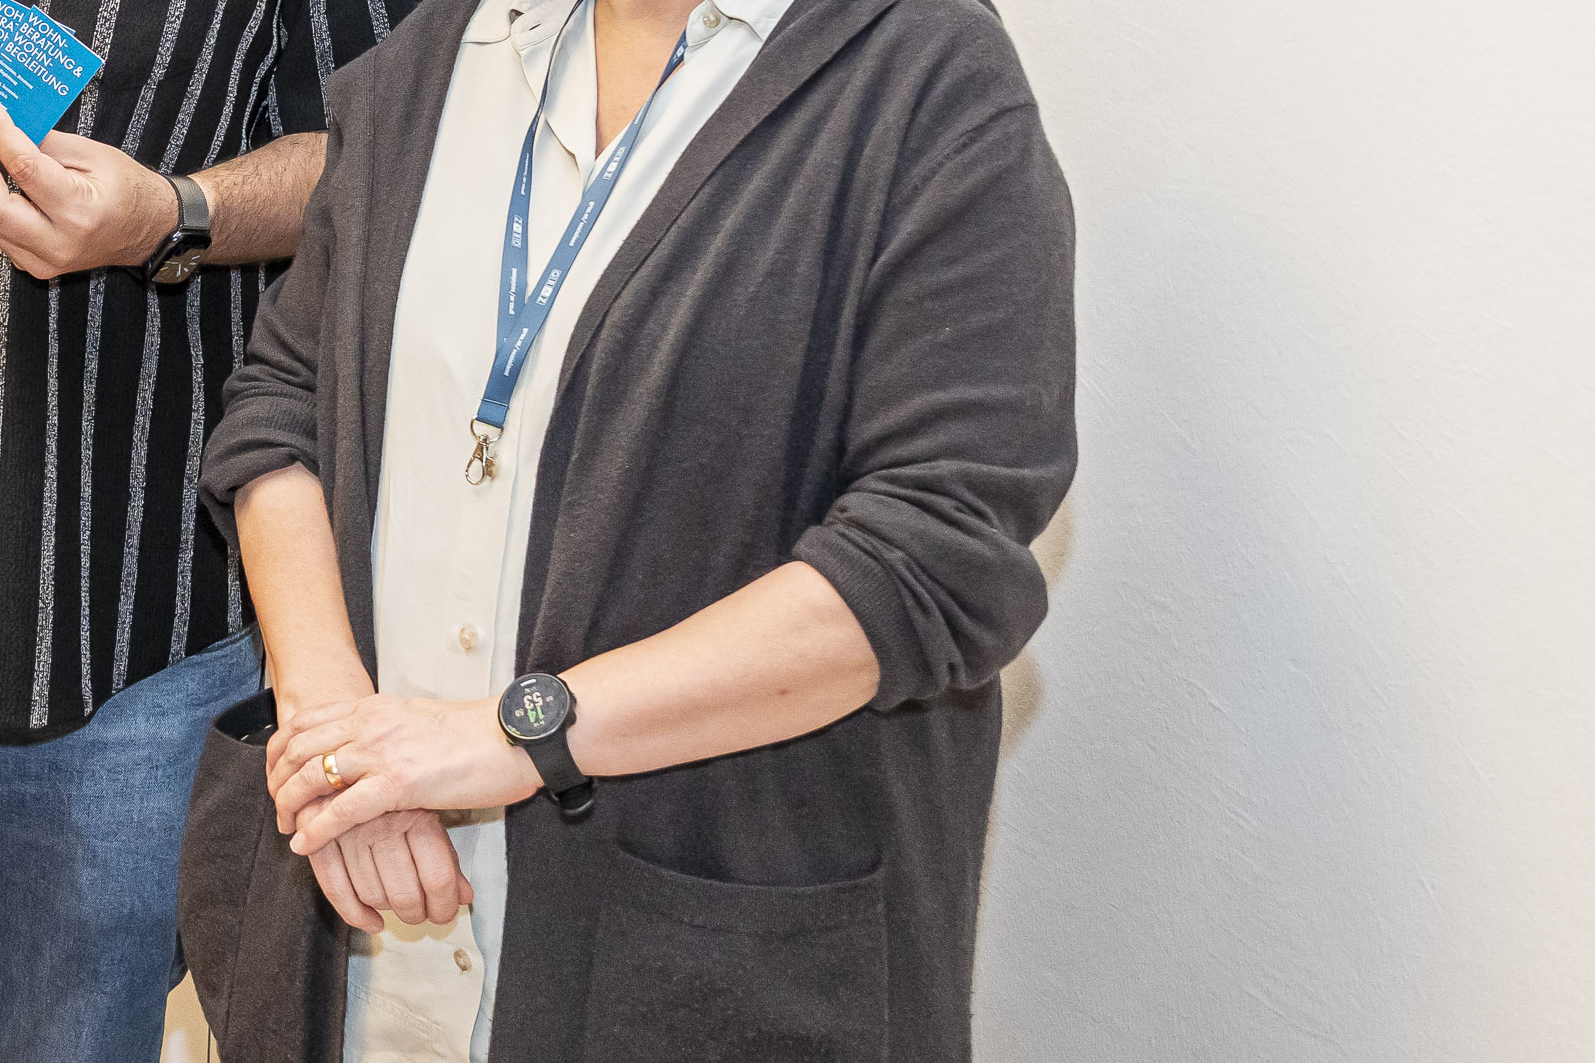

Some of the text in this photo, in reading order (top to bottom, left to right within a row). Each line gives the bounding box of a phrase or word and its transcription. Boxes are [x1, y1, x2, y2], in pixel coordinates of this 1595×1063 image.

[13, 31, 54, 68] WOHN-
[19, 23, 83, 78] BERATUNG &
[28, 12, 69, 48] WOHN-
[4, 41, 70, 96] BEGLEITUNG
